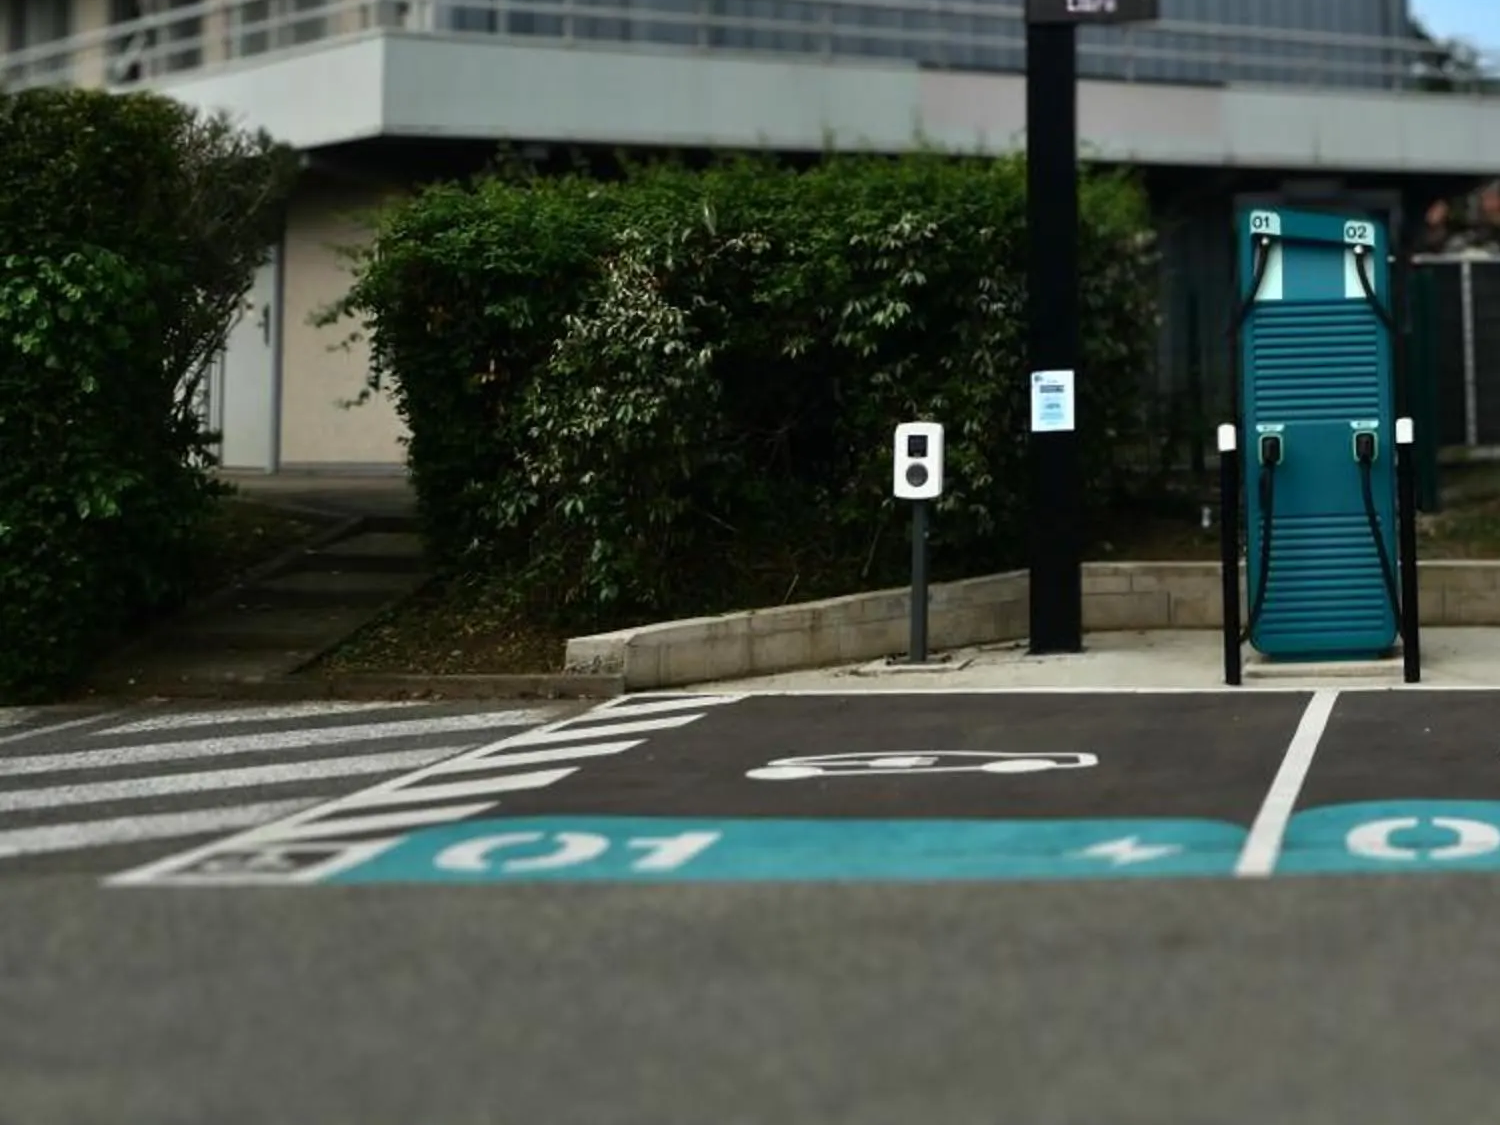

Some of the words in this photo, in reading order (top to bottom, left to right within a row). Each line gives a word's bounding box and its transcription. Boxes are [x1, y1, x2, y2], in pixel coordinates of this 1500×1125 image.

[1253, 216, 1270, 229] 01
[1346, 226, 1367, 239] 02
[432, 830, 724, 874] 01
